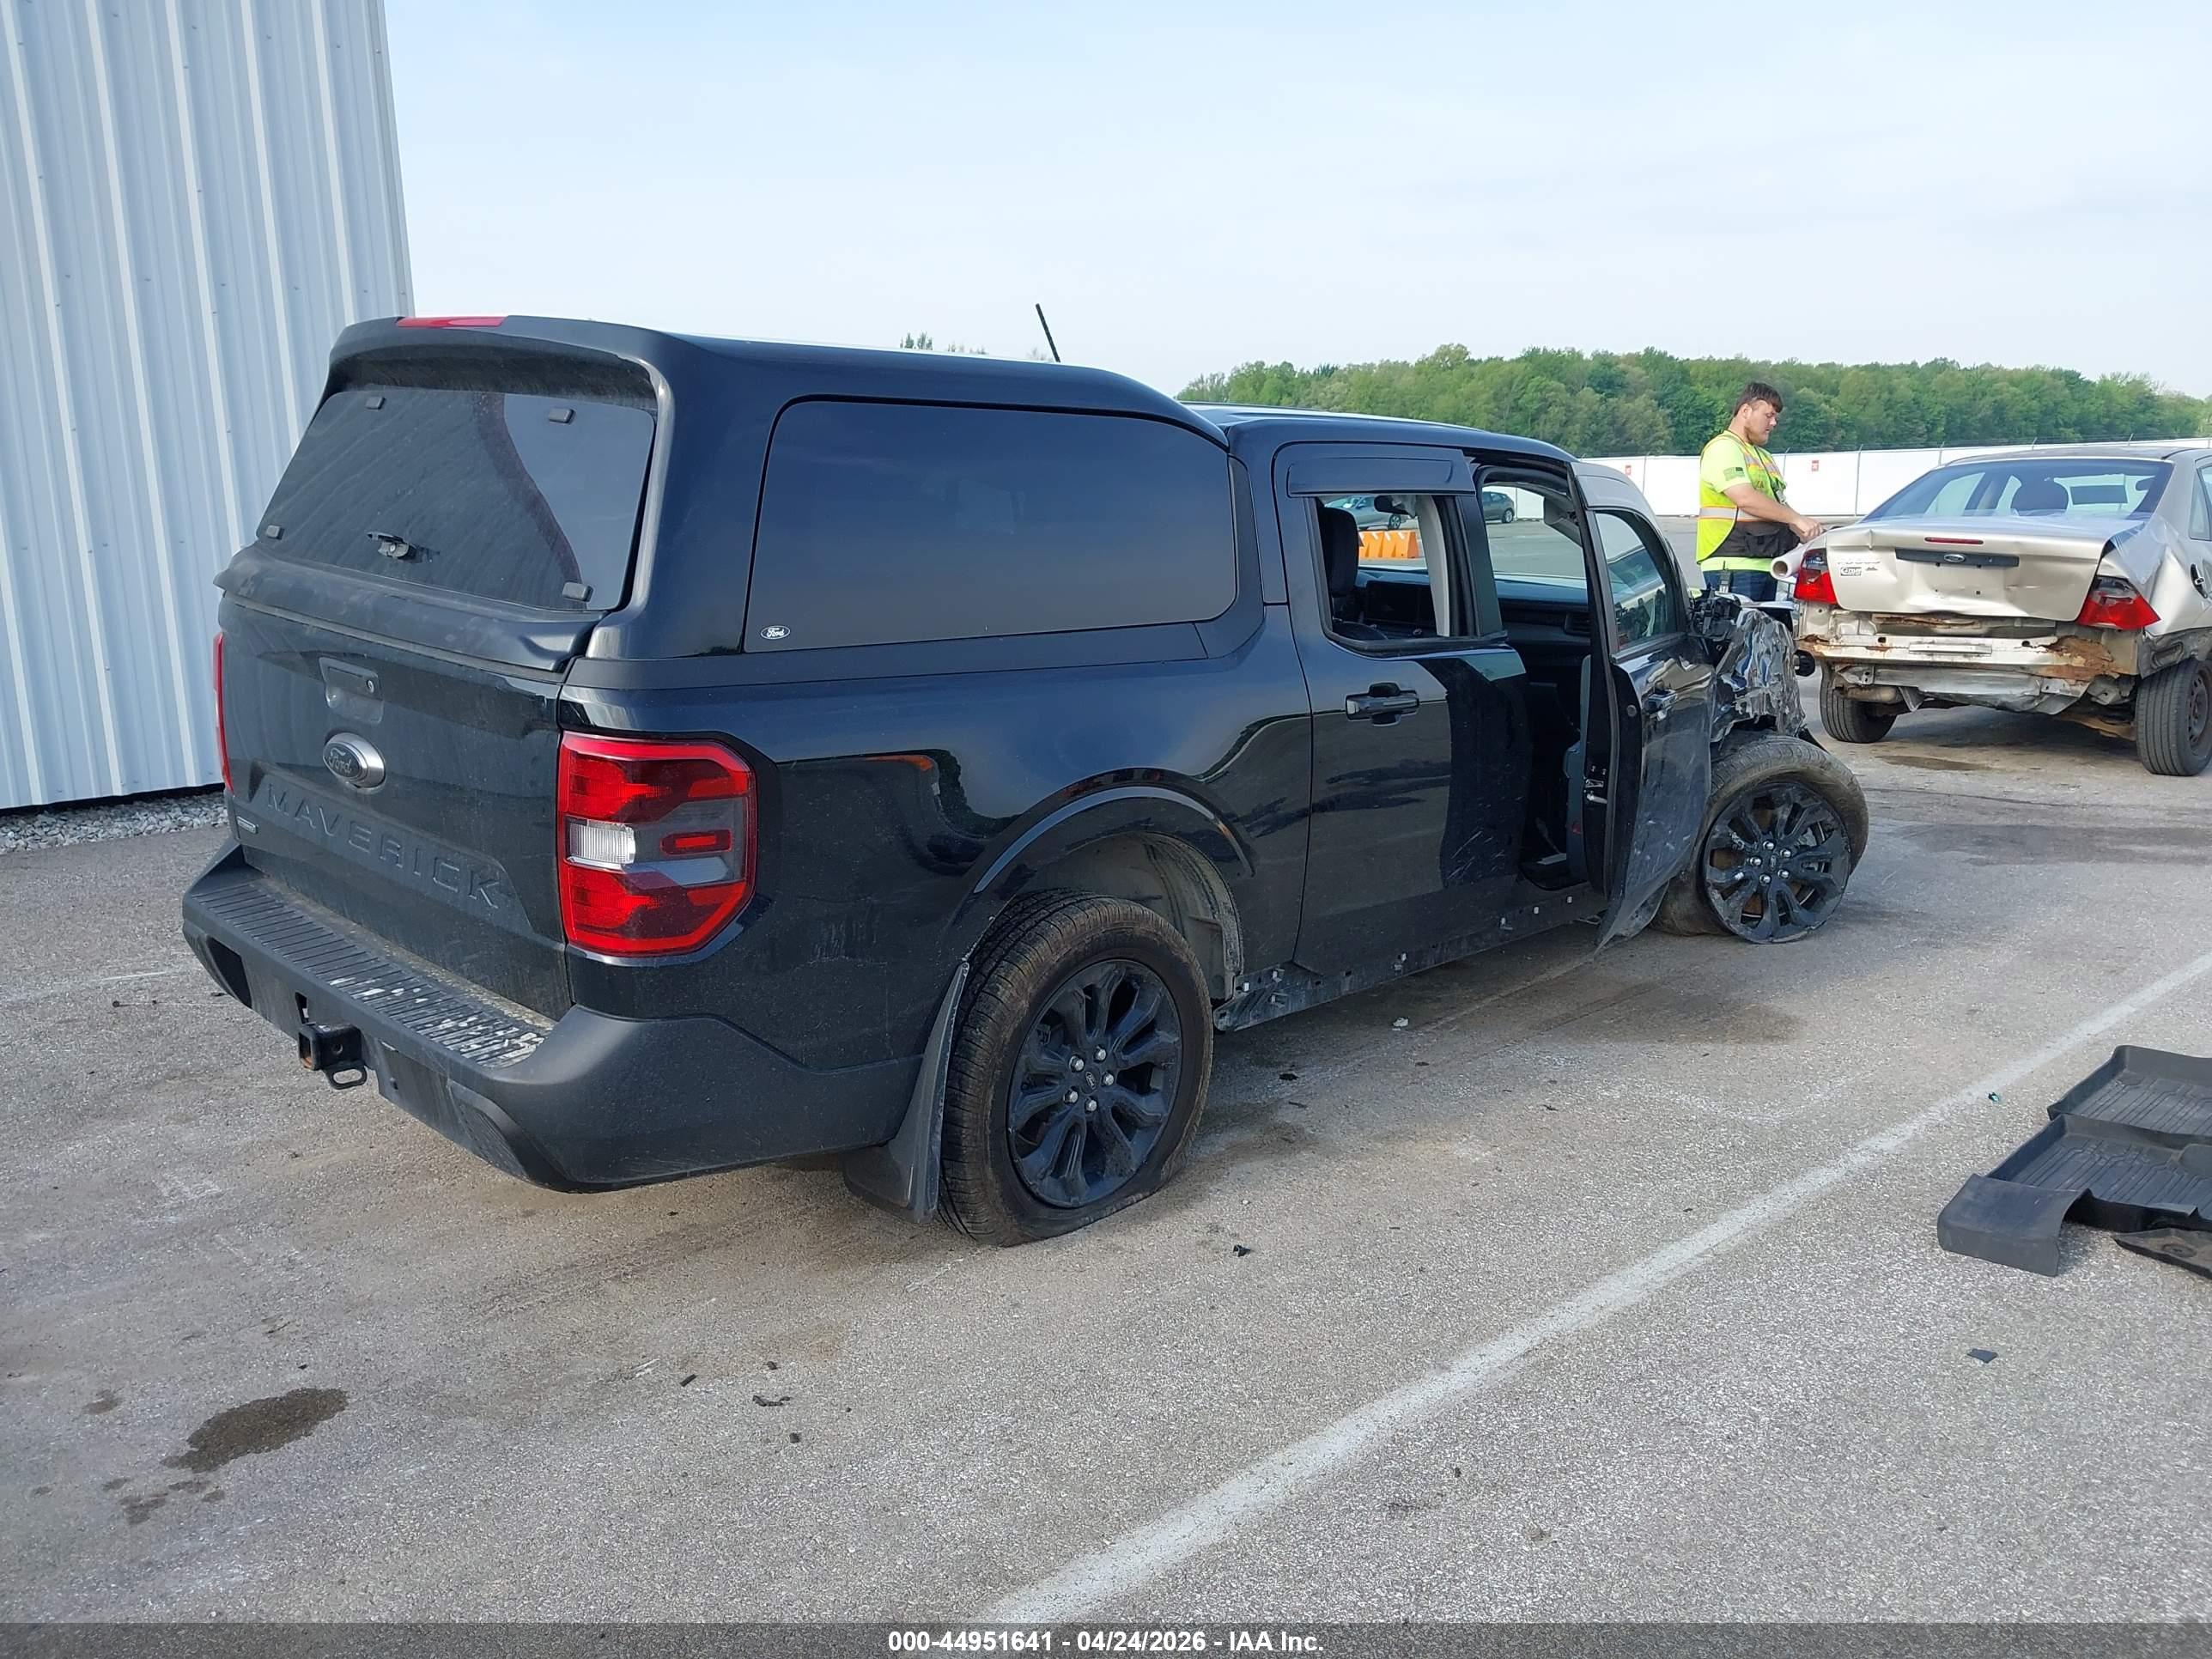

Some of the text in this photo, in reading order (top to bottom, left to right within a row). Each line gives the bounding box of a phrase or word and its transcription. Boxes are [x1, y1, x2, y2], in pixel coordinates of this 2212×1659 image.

[765, 627, 786, 638] Ford
[326, 747, 354, 775] Ford
[267, 782, 501, 908] MAVERICK
